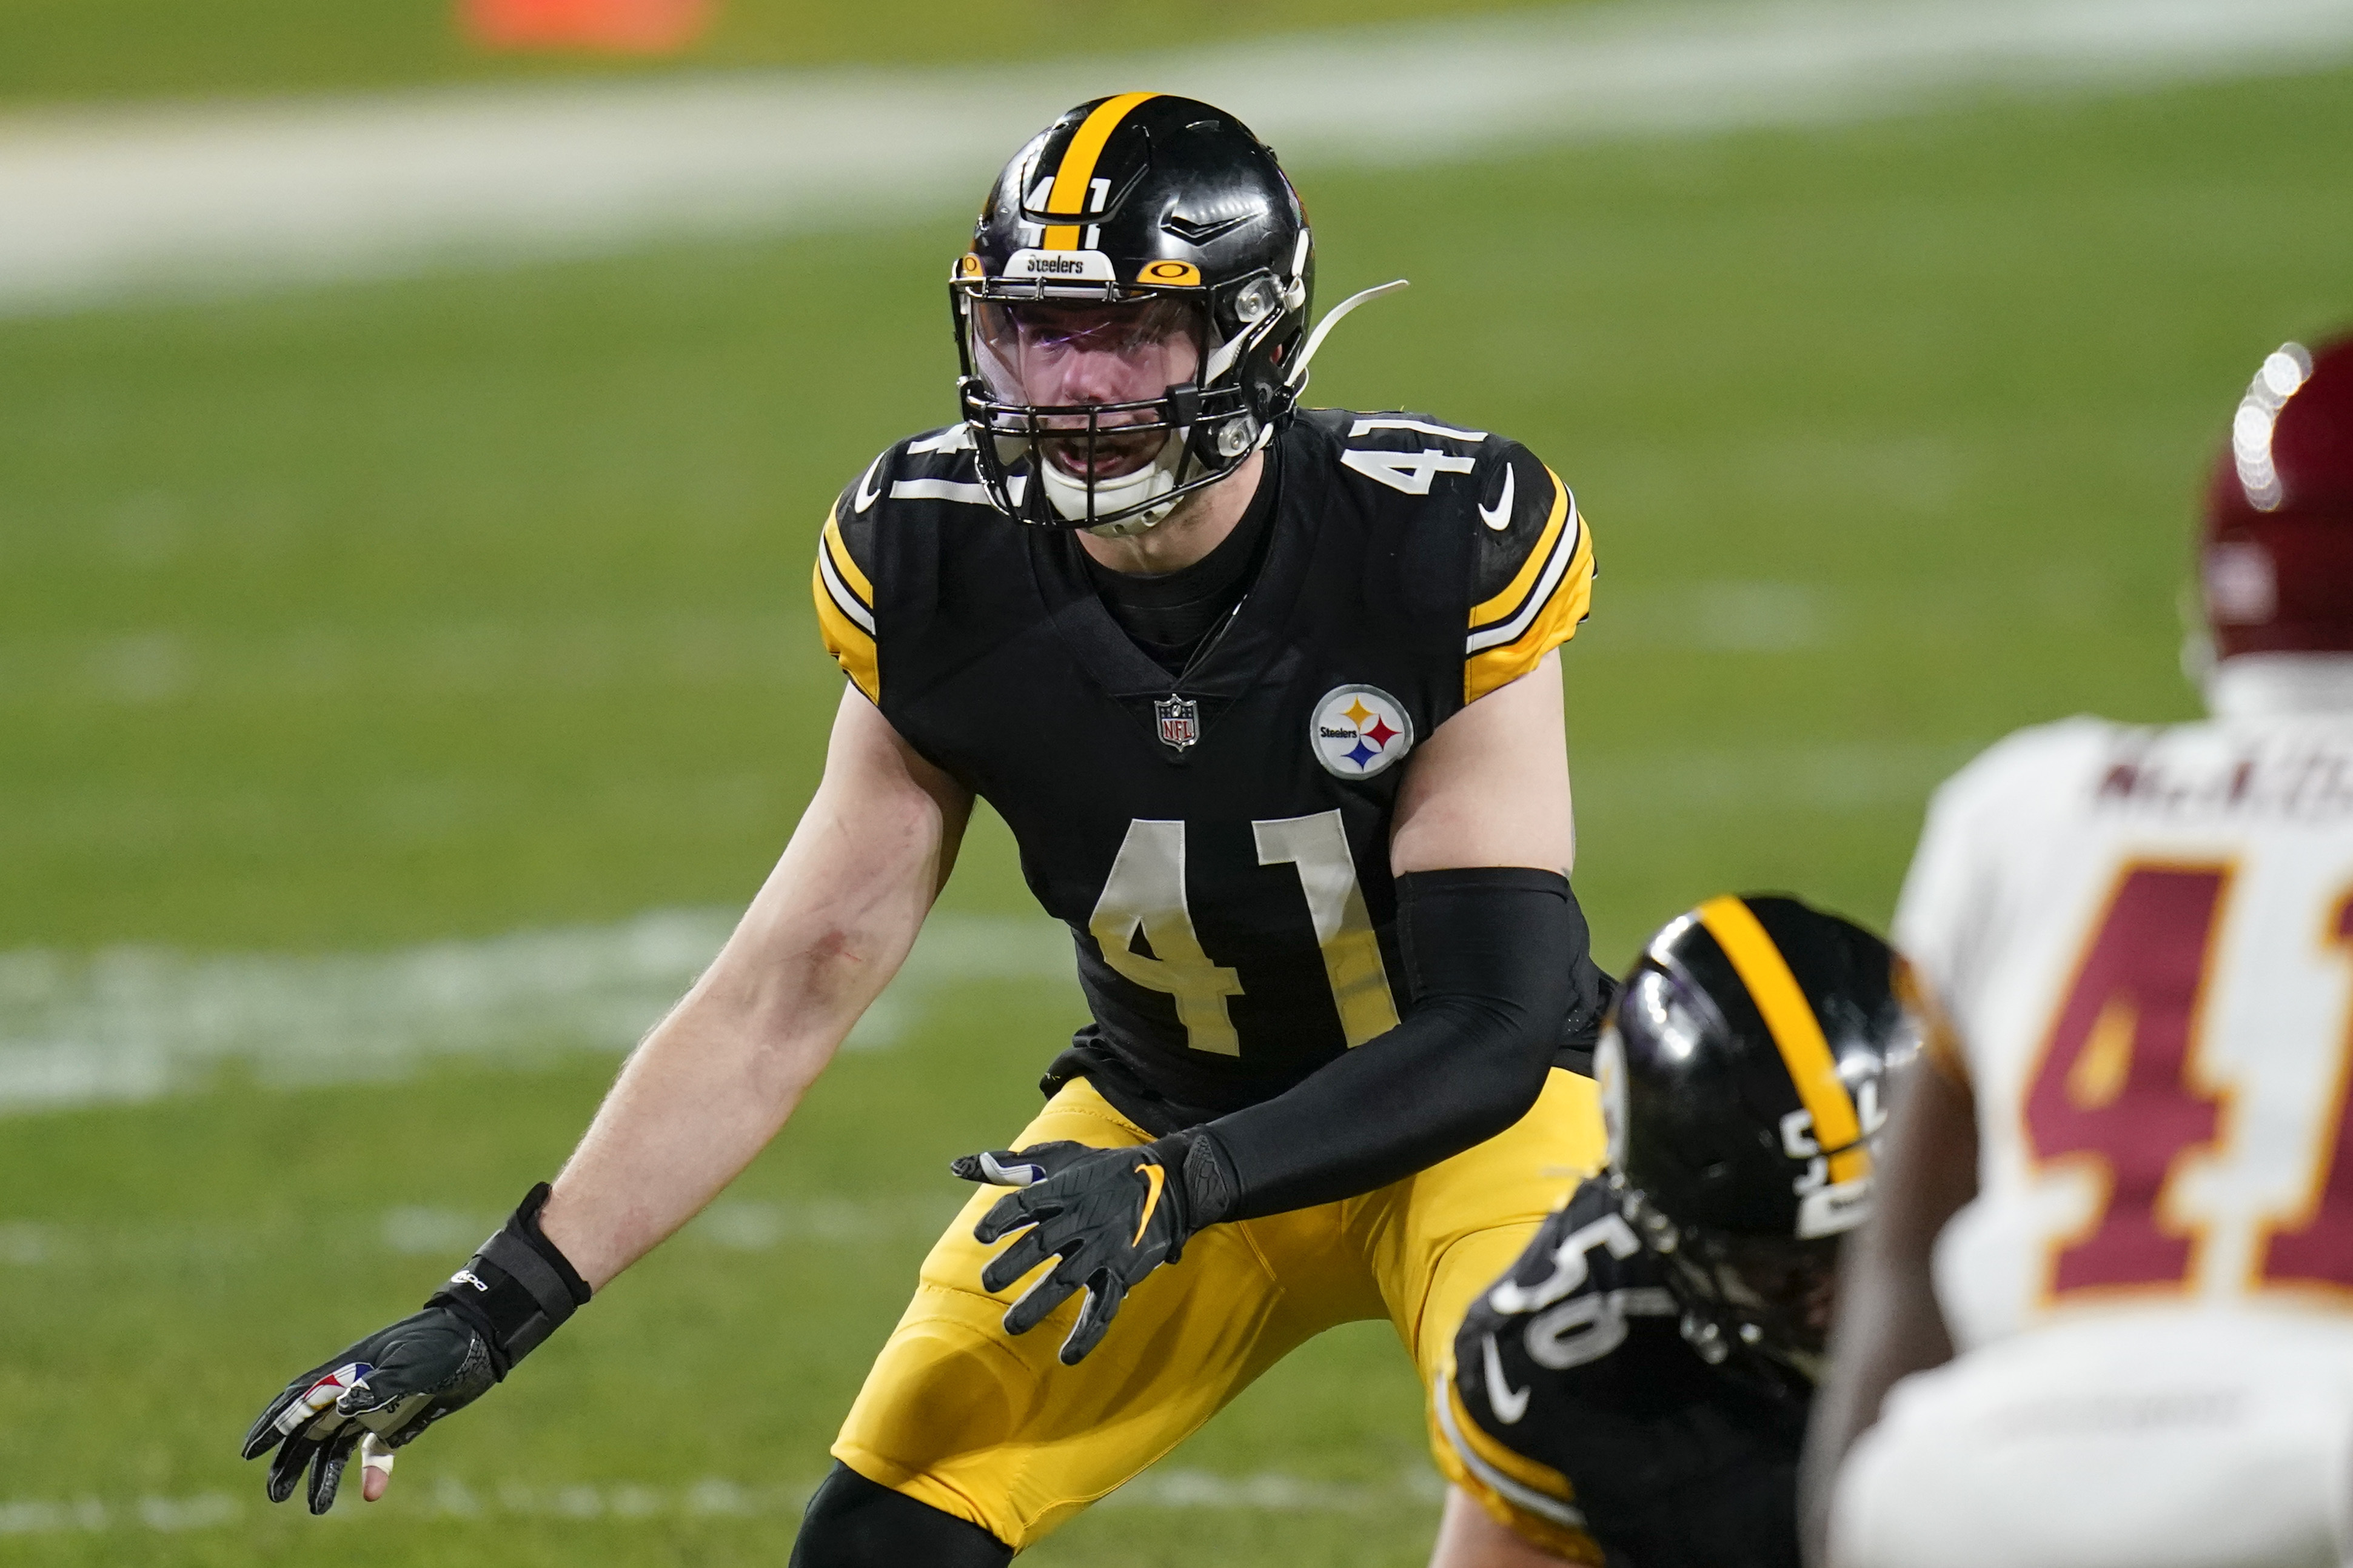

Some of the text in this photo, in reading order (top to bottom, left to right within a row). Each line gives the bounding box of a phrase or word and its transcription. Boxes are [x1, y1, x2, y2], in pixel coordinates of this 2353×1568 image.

[1019, 176, 1111, 250] 41
[1028, 255, 1083, 273] Steelers
[1340, 419, 1488, 495] 41
[1163, 721, 1191, 739] NFL
[1320, 727, 1357, 739] Steelers
[1089, 809, 1401, 1056] 41
[1490, 1213, 1678, 1371] 56
